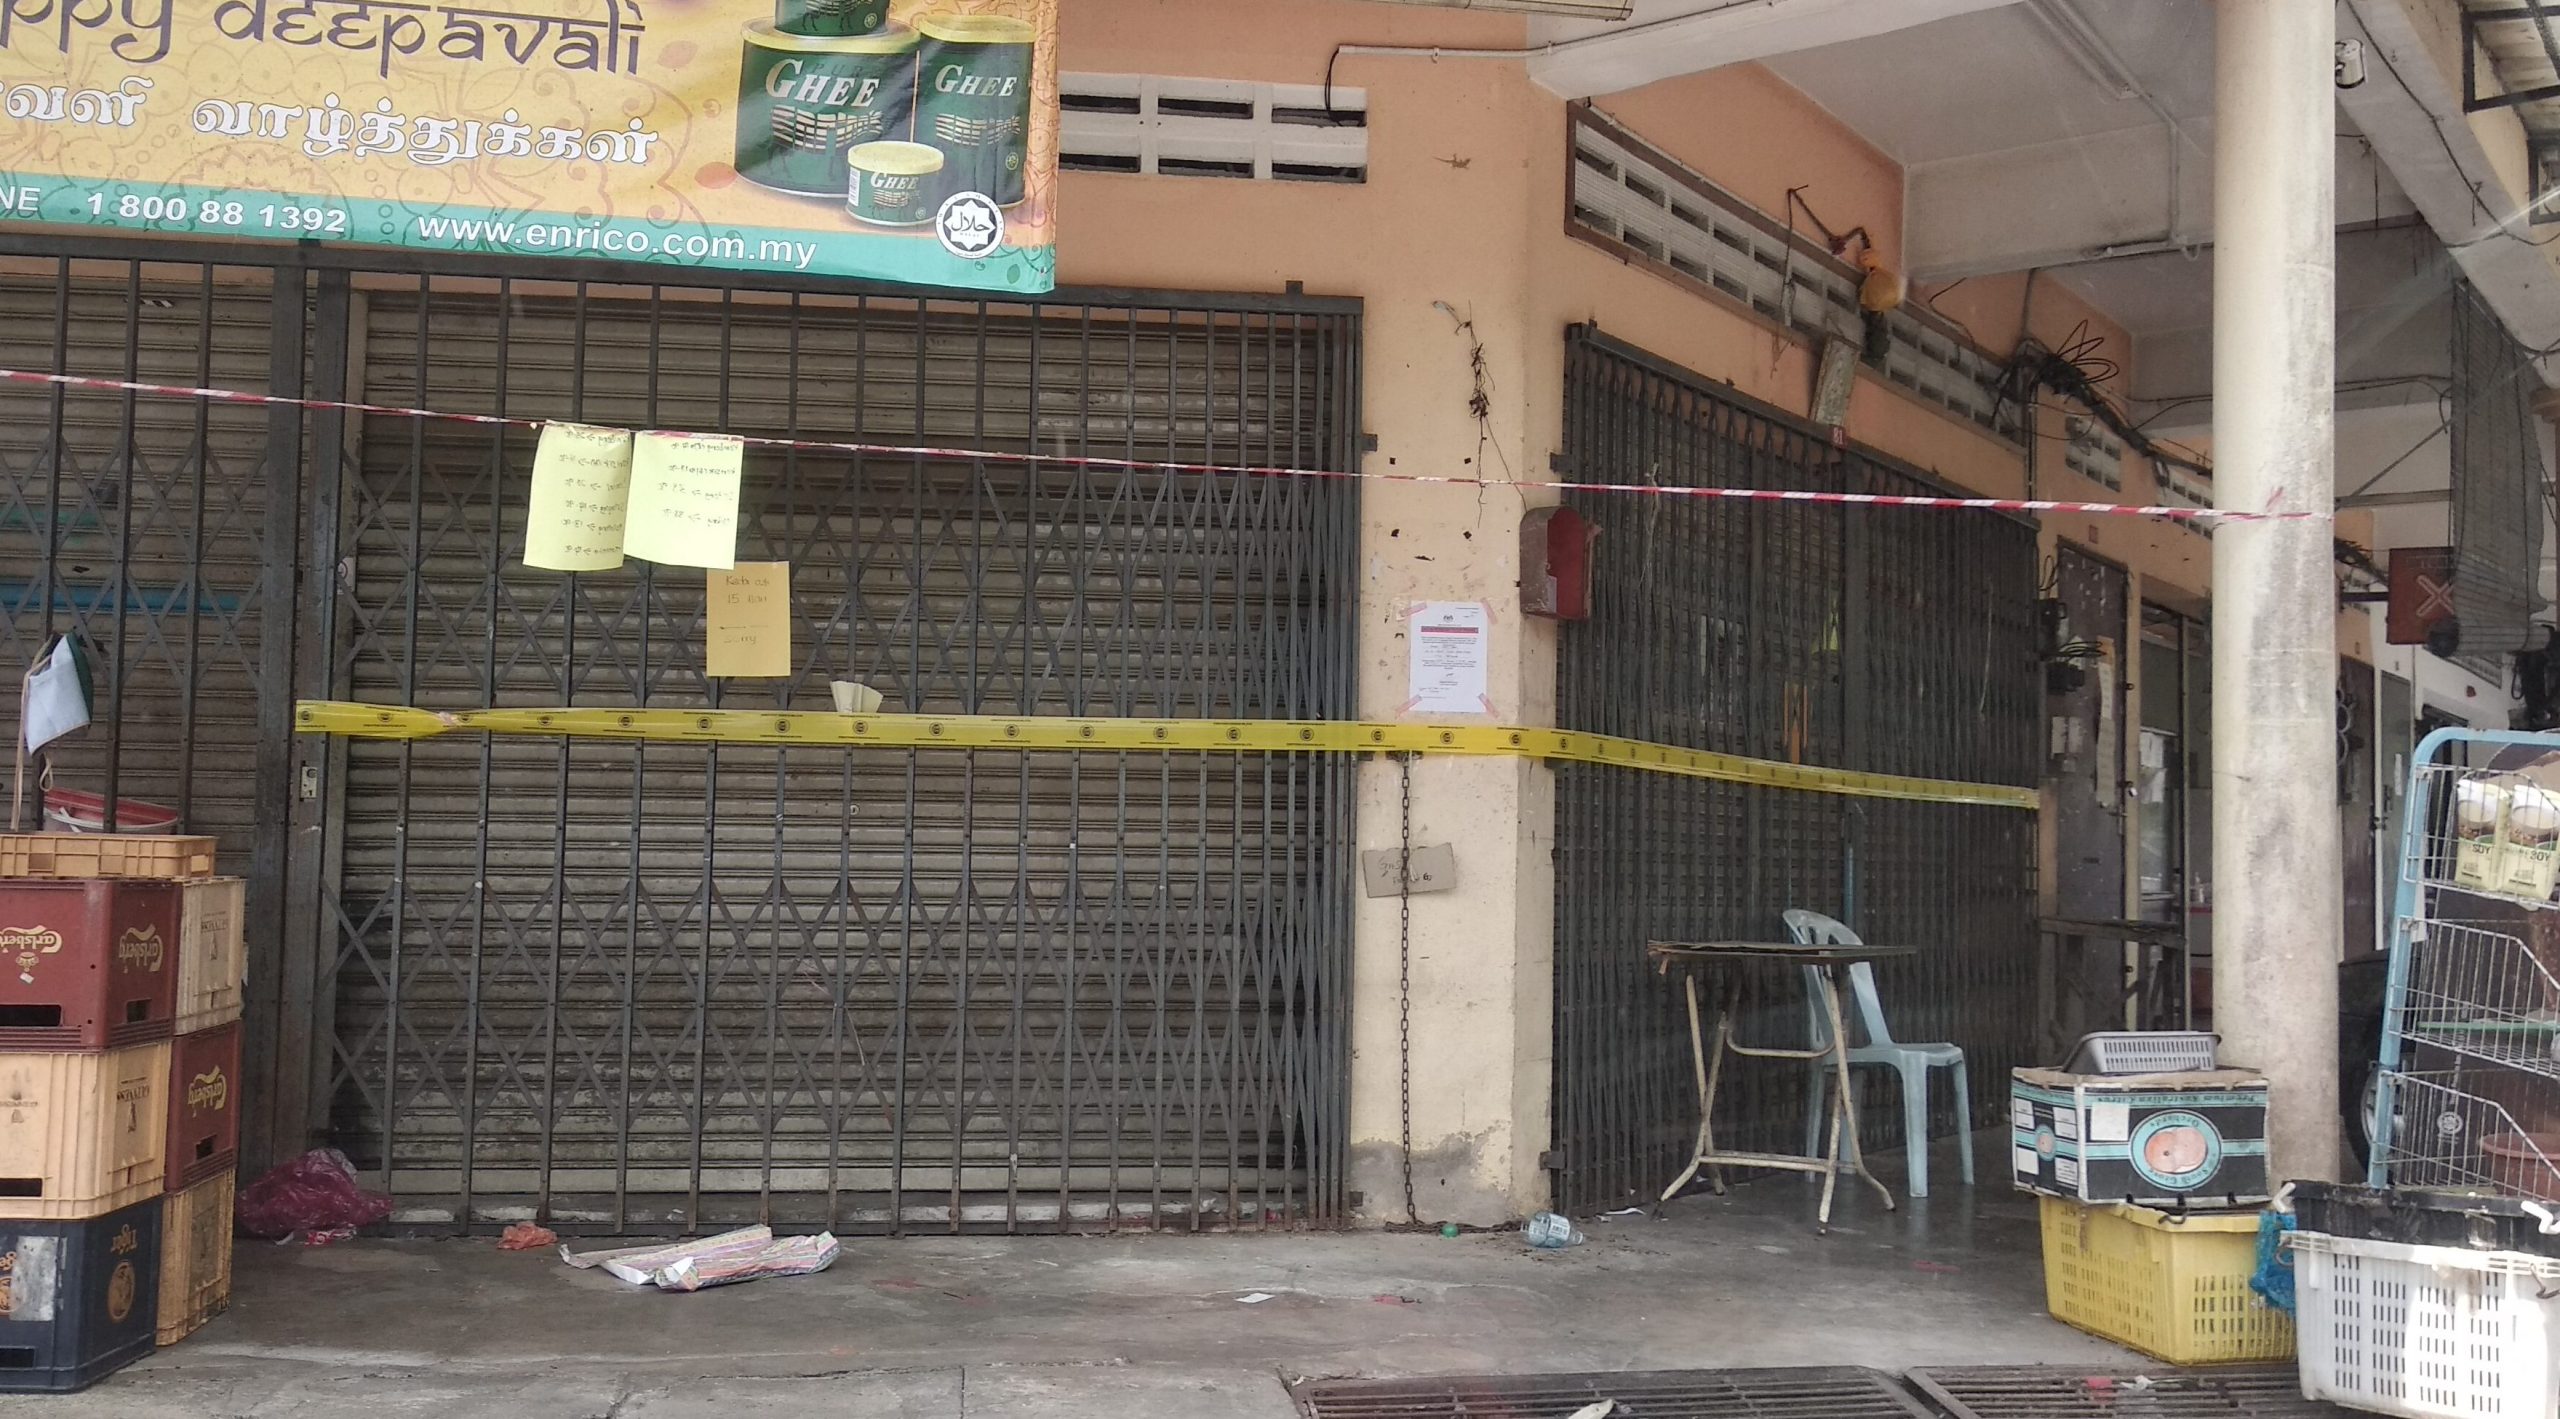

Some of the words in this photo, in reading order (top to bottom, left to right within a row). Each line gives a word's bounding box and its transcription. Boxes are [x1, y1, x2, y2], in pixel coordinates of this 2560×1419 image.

[213, 0, 647, 79] deepavali
[0, 76, 156, 127] வளி
[191, 91, 660, 166] வாழ்த்துக்கள்
[87, 192, 104, 216] 1
[118, 193, 187, 221] 800
[199, 199, 244, 226] 88
[258, 203, 347, 233] 1392
[417, 213, 818, 270] www.enrico.com.my
[119, 923, 164, 974] Carlsberg
[188, 1065, 228, 1119] Carlsberg
